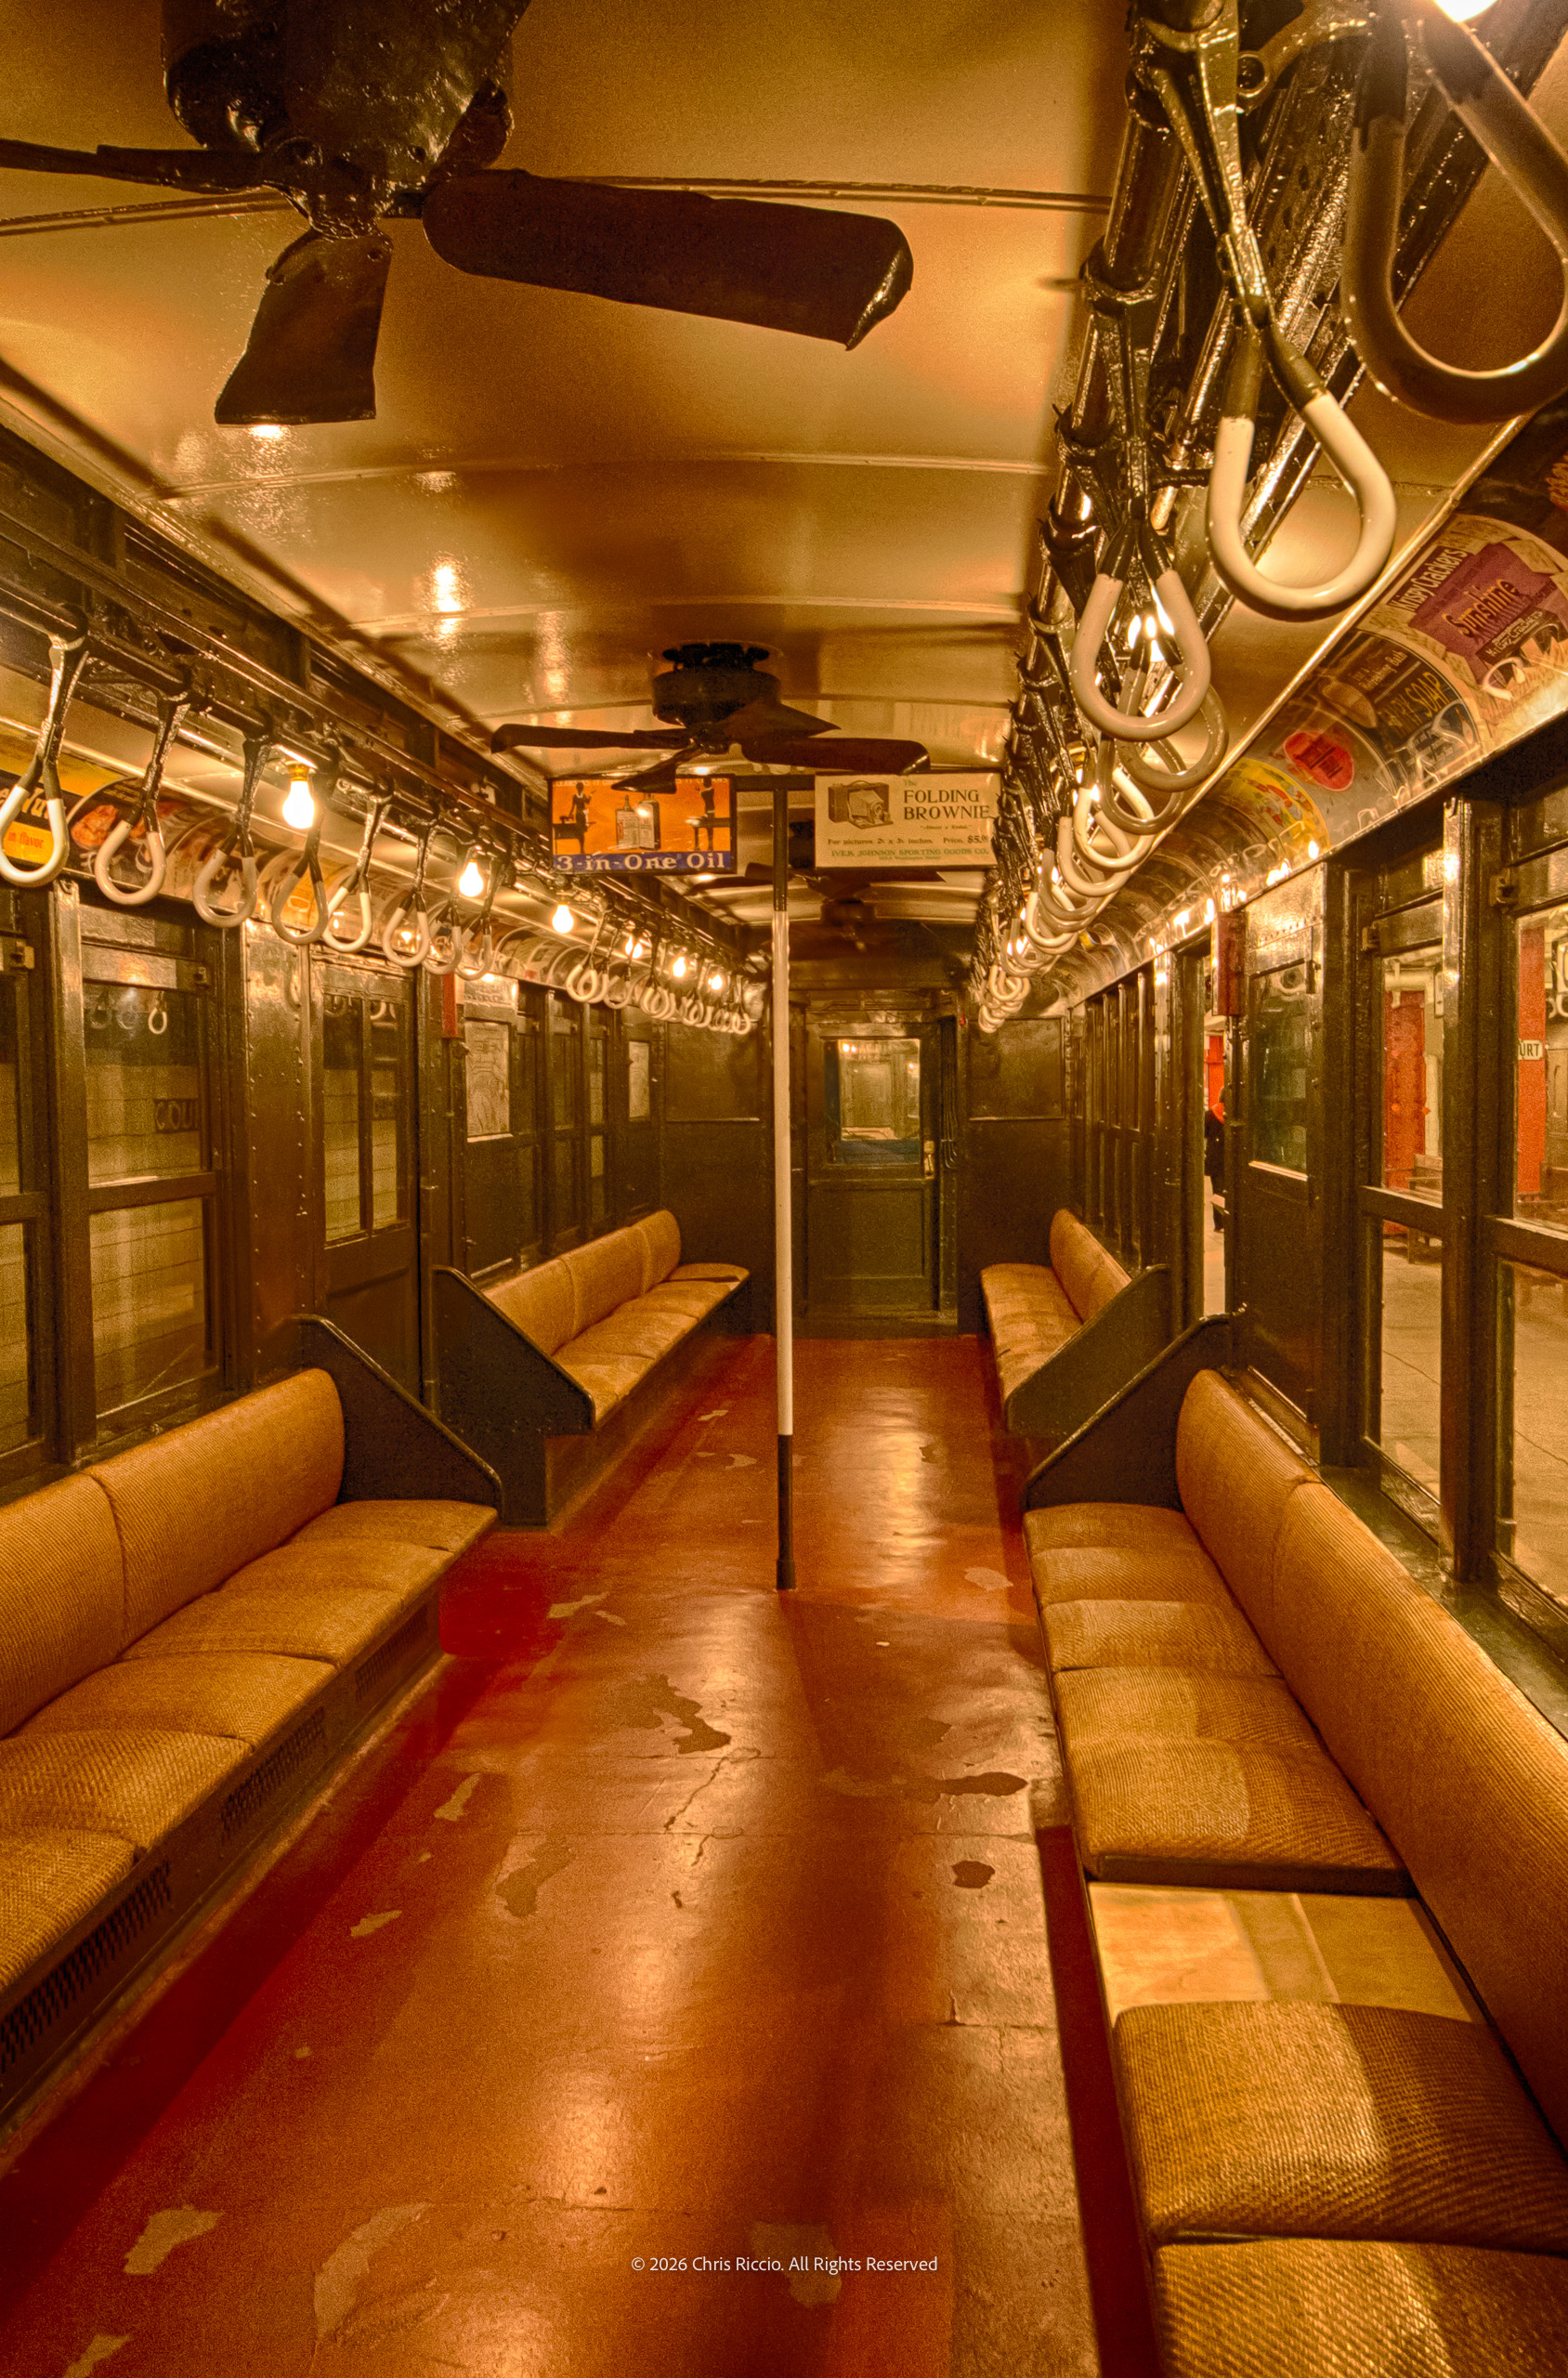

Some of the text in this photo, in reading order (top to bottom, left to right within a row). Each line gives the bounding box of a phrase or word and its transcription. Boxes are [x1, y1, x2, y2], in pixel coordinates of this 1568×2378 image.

[1411, 549, 1468, 587] Crackers
[1442, 579, 1519, 638] Sunshine
[1405, 672, 1450, 718] SOAP
[903, 778, 917, 787] The
[904, 789, 980, 804] FOLDING
[904, 805, 990, 821] BROWNIE
[20, 831, 45, 849] flavor
[557, 852, 725, 870] 3-in-One Oil
[857, 849, 896, 857] JOHNSON
